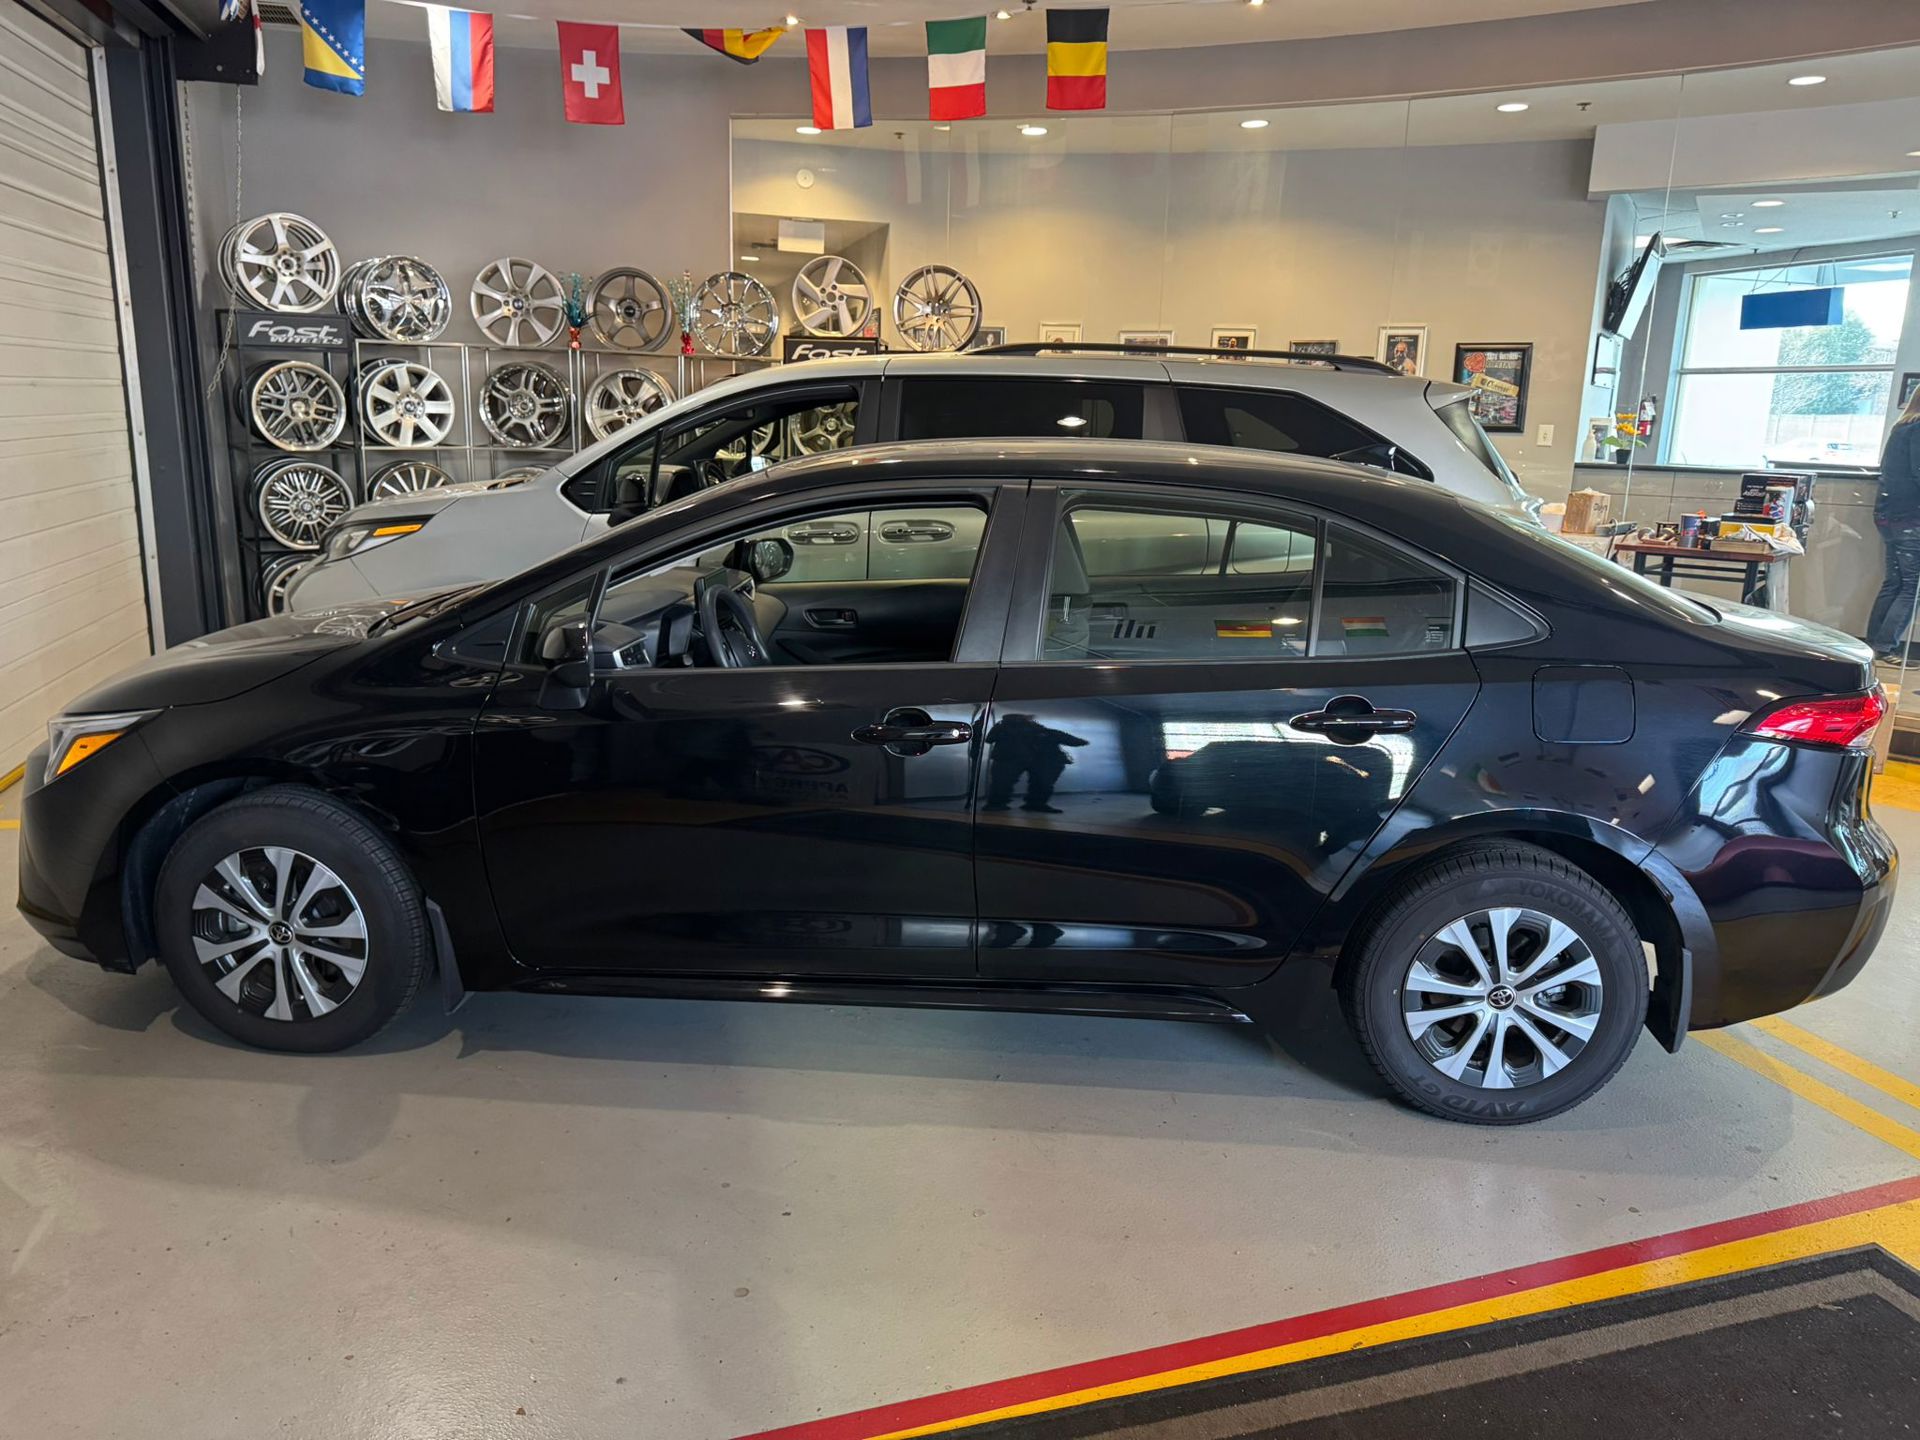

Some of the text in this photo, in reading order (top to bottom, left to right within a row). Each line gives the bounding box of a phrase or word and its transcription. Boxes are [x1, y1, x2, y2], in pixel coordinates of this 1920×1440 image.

[248, 320, 337, 338] Fast
[791, 344, 868, 360] Fast
[1519, 881, 1618, 945] YOKOHAMA
[1440, 1094, 1526, 1118] AVID
